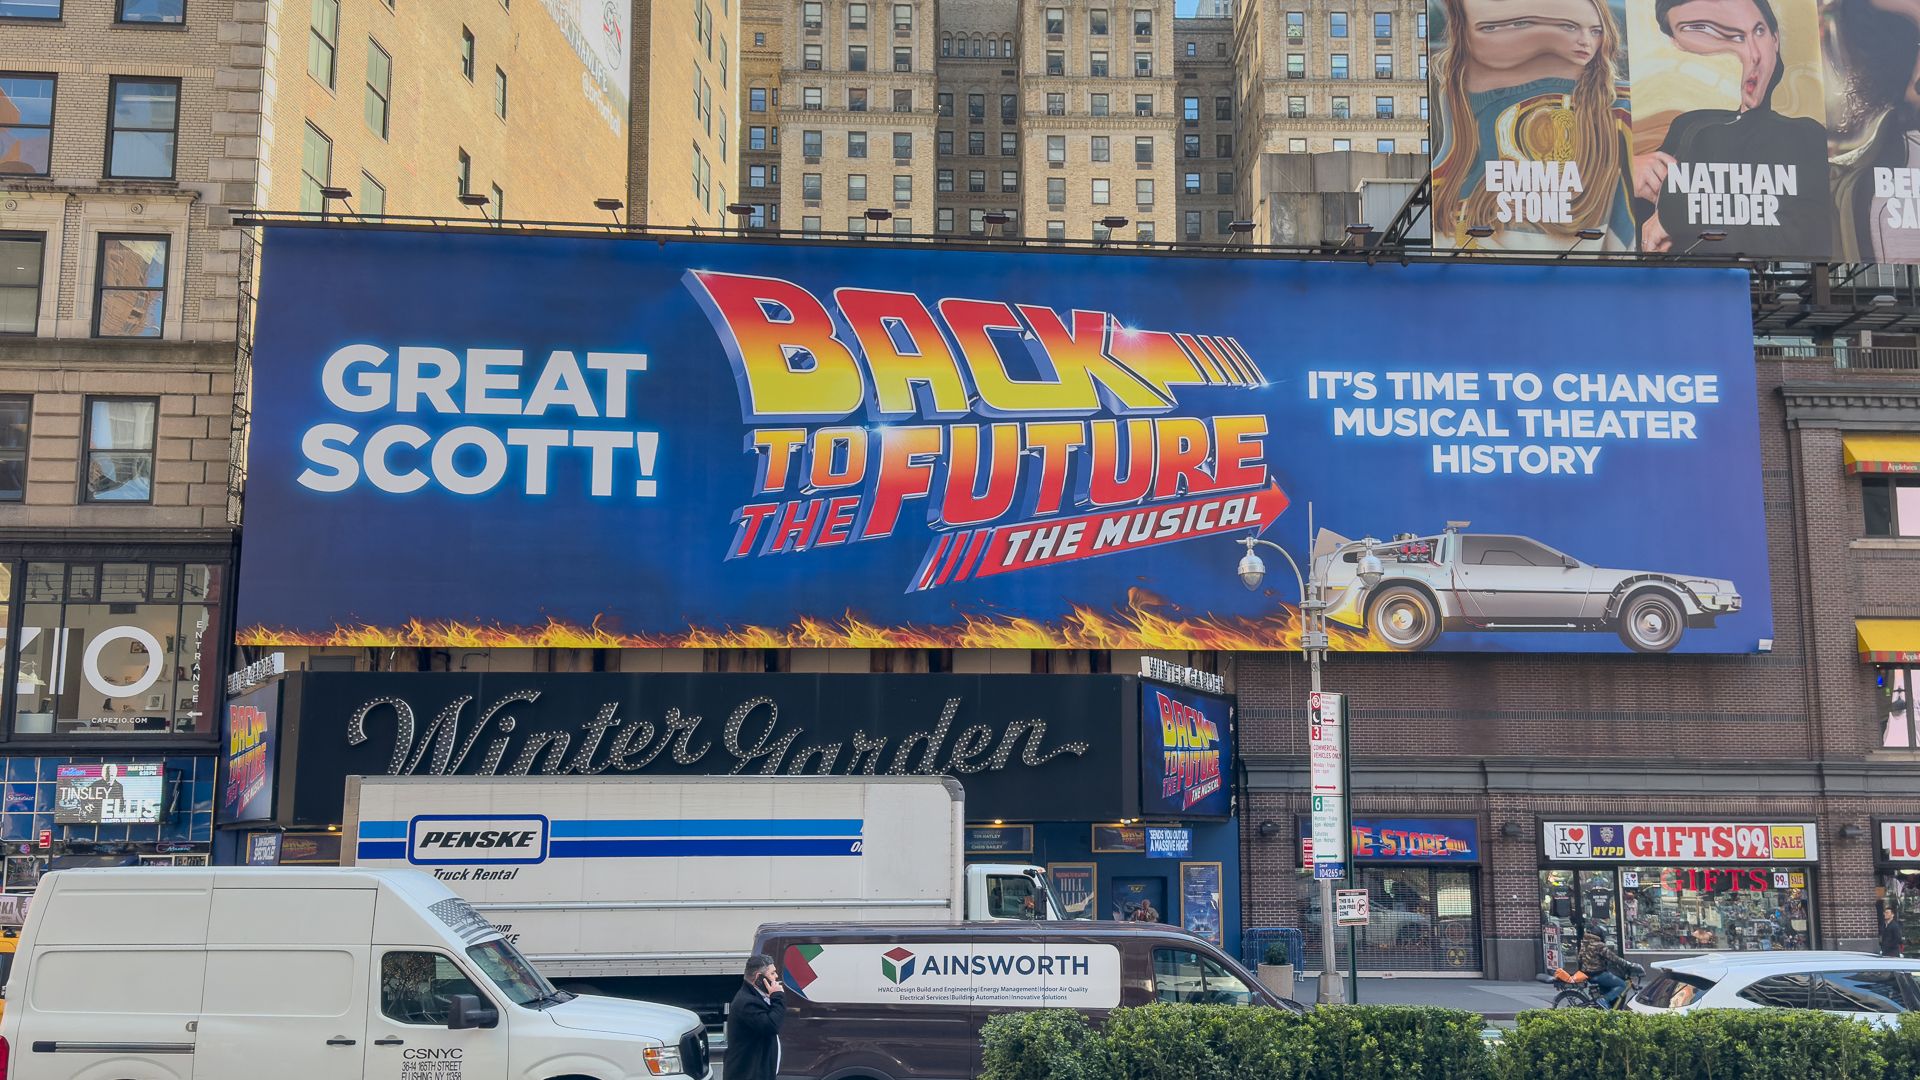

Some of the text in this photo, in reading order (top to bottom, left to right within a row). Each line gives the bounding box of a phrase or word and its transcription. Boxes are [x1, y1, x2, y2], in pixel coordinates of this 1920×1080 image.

[1485, 161, 1583, 193] EMMA
[1667, 162, 1797, 196] NATHAN
[1497, 191, 1573, 224] STONE
[1688, 194, 1780, 227] FIELDER
[1887, 197, 1920, 229] SA
[682, 269, 1268, 424] BACK
[321, 344, 648, 418] GREAT
[1308, 371, 1720, 403] IT'S TIME TO CHANGE
[1333, 408, 1698, 439] MUSICAL THEATER
[296, 423, 660, 498] SCOTT!
[1432, 444, 1603, 475] HISTORY
[745, 414, 1269, 541] TO FUTURE
[725, 495, 863, 561] THE
[1002, 496, 1264, 567] THE MUSICAL
[192, 620, 204, 703] ENTRANCE
[229, 704, 268, 757] BACK
[347, 689, 1089, 775] Winter Garden
[1156, 691, 1219, 749] BACK
[1313, 727, 1319, 739] 3
[1164, 750, 1220, 792] TO FUTURE
[60, 787, 112, 800] TINSLEY
[1191, 777, 1220, 802] THE MUSICAL
[1315, 797, 1321, 810] 6
[101, 799, 157, 818] ELLIS
[419, 831, 538, 848] PENSKE
[1155, 840, 1175, 851] MASSIVE
[1164, 830, 1172, 840] YOU
[1173, 830, 1181, 840] OUT
[1182, 830, 1188, 840] ON
[1381, 829, 1451, 857] STORE
[1559, 842, 1586, 855] NY
[1560, 828, 1567, 841] I
[1628, 825, 1735, 858] GIFTS
[1773, 835, 1803, 849] SALE
[1592, 846, 1624, 857] NYPD
[434, 867, 520, 881] Truck Rental
[1319, 868, 1339, 878] 104265
[1660, 868, 1768, 892] GIFTS
[1791, 875, 1803, 885] SALE
[921, 955, 1089, 976] AINSWORTH
[402, 1061, 463, 1071] 36-14 165TH STREET
[403, 1048, 463, 1059] CSNYC
[401, 1071, 462, 1080] FLUSHING NY 11358
